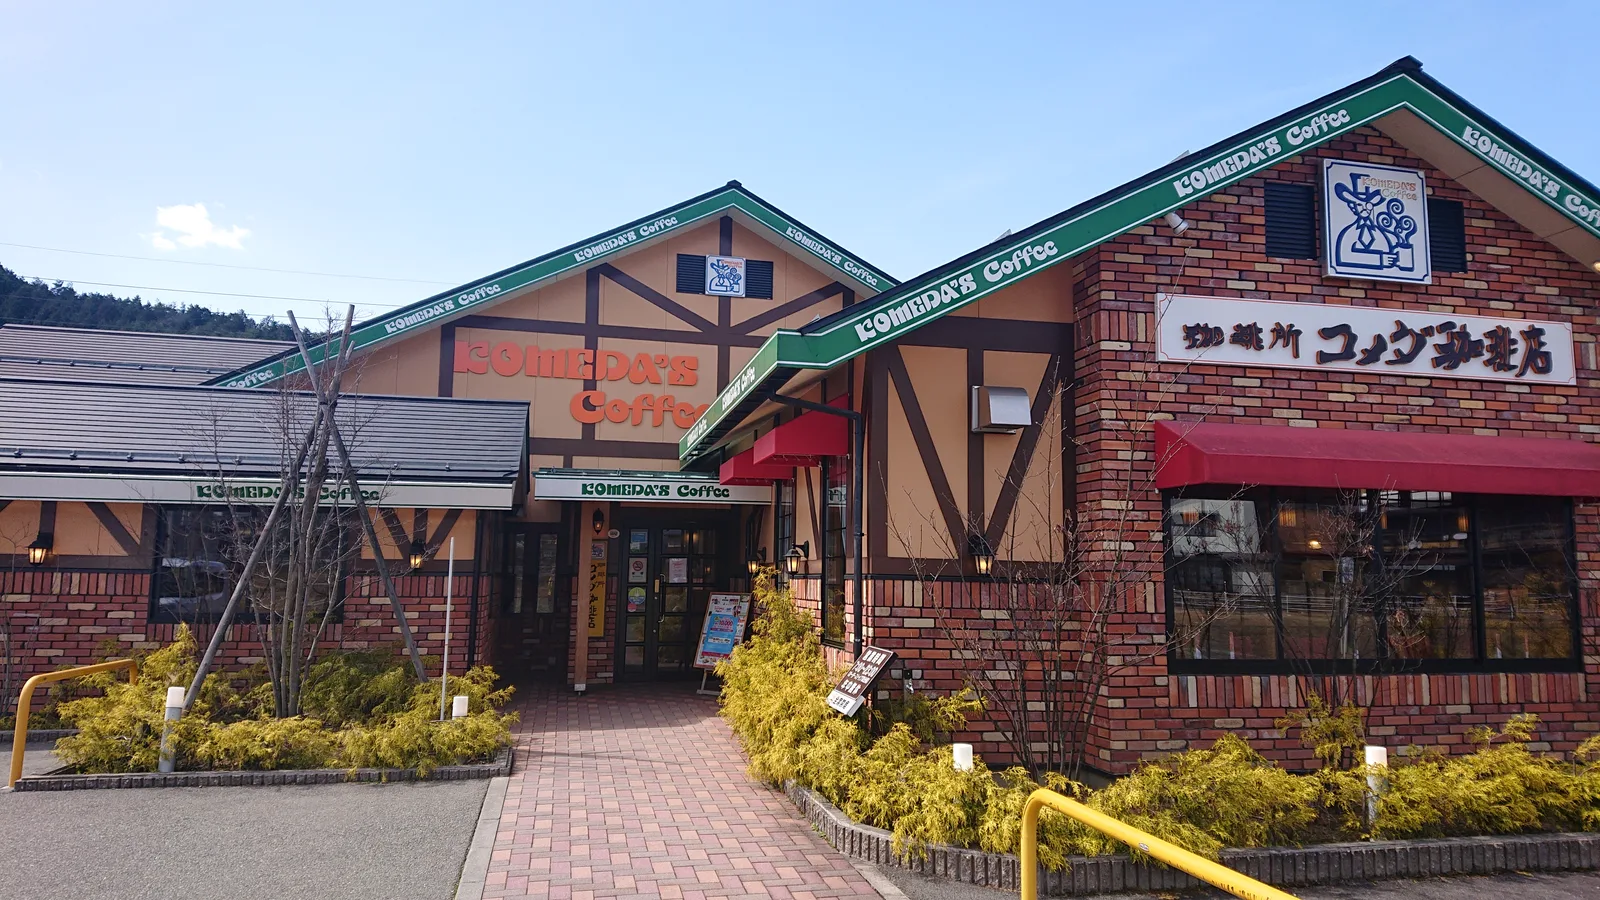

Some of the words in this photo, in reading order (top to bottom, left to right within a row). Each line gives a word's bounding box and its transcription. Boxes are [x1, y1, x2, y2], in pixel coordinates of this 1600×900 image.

[1173, 136, 1282, 198] KOMEDA'S
[1286, 109, 1351, 146] Coffee
[1462, 125, 1561, 198] KOMEDA'S
[1361, 176, 1417, 192] KOMEDA'S
[1381, 188, 1417, 201] Coffee
[574, 230, 637, 262] KOMEDA'S
[639, 216, 678, 236] Coffee
[785, 226, 842, 264] KOMEDA'S
[843, 261, 878, 286] Coffee
[384, 299, 455, 333] KOMEDA'S
[457, 284, 501, 306] Coffee
[854, 272, 977, 343] KOMEDA'S
[983, 240, 1059, 283] Coffee
[453, 341, 698, 386] KOMEDA'S
[196, 485, 305, 499] KOMEDS
[318, 487, 380, 500] Cofee
[581, 482, 670, 497] KOMEDA'S
[677, 484, 730, 498] Coffee
